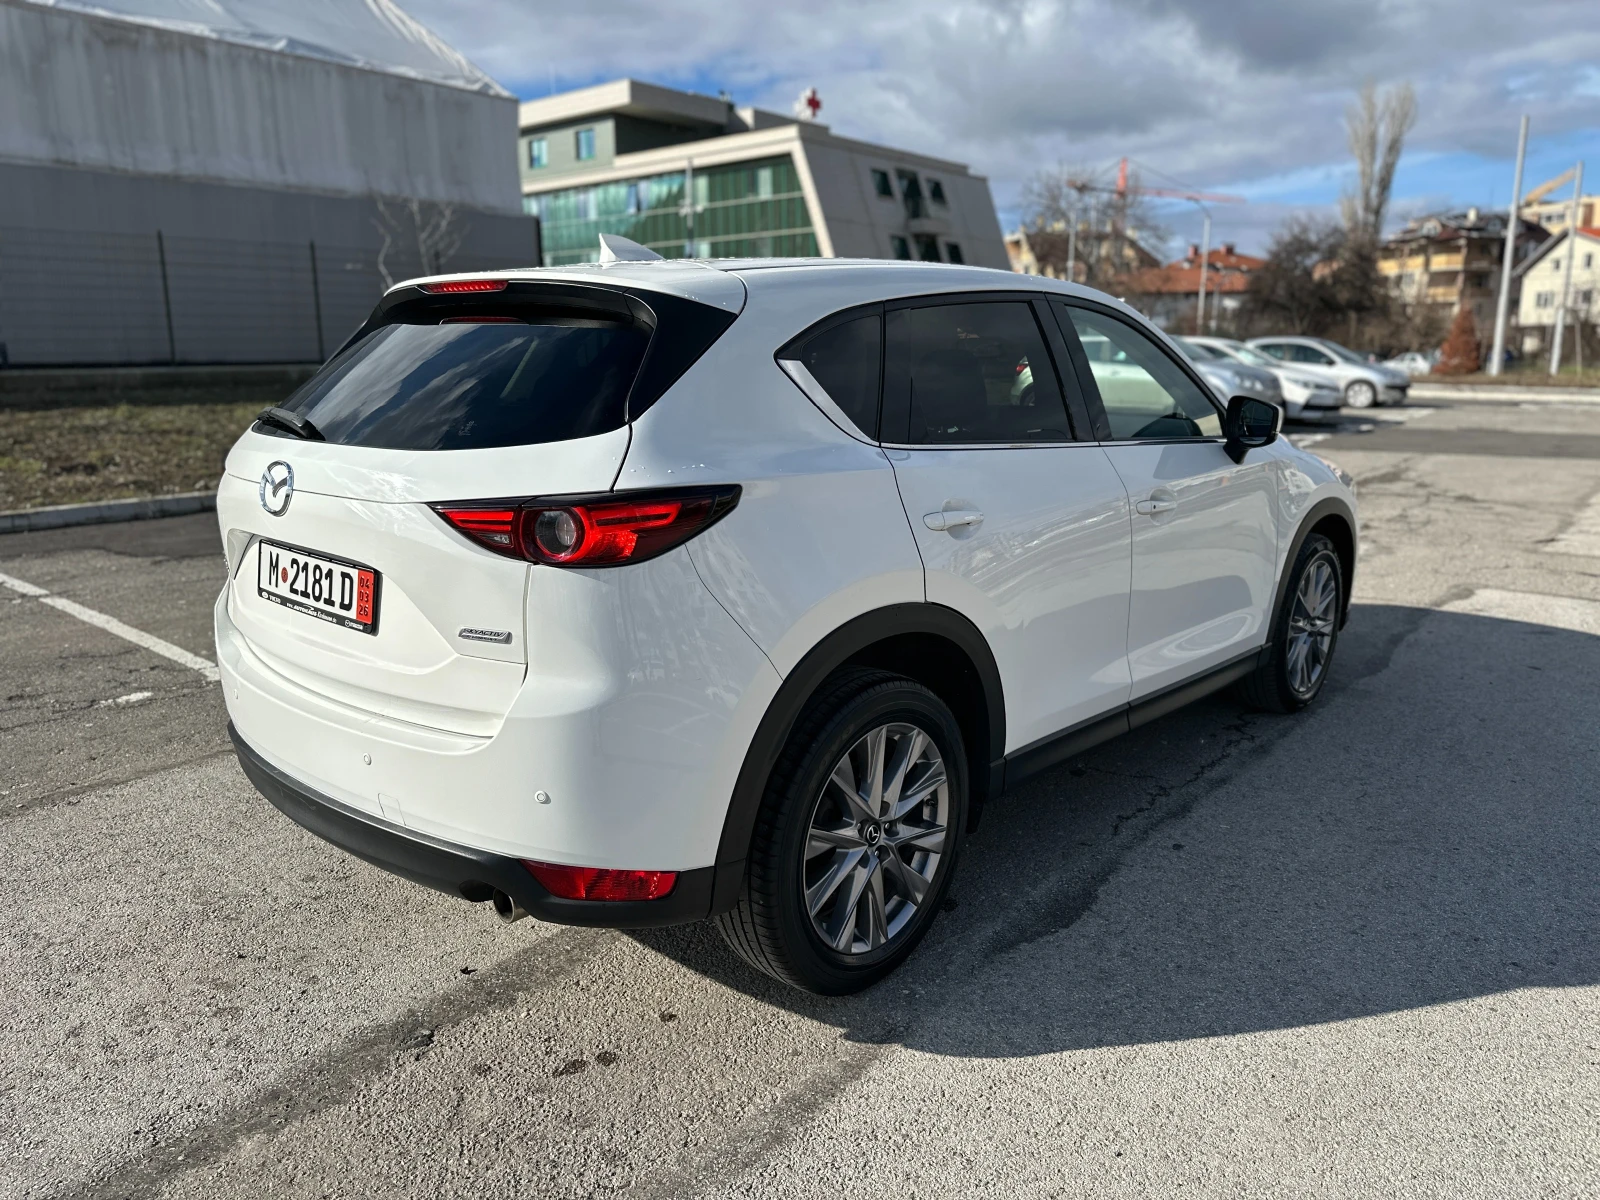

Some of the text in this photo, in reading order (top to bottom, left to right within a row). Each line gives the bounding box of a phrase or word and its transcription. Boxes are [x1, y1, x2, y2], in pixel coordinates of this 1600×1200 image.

[359, 577, 370, 589] 04
[359, 590, 370, 603] 03
[358, 605, 369, 617] 26
